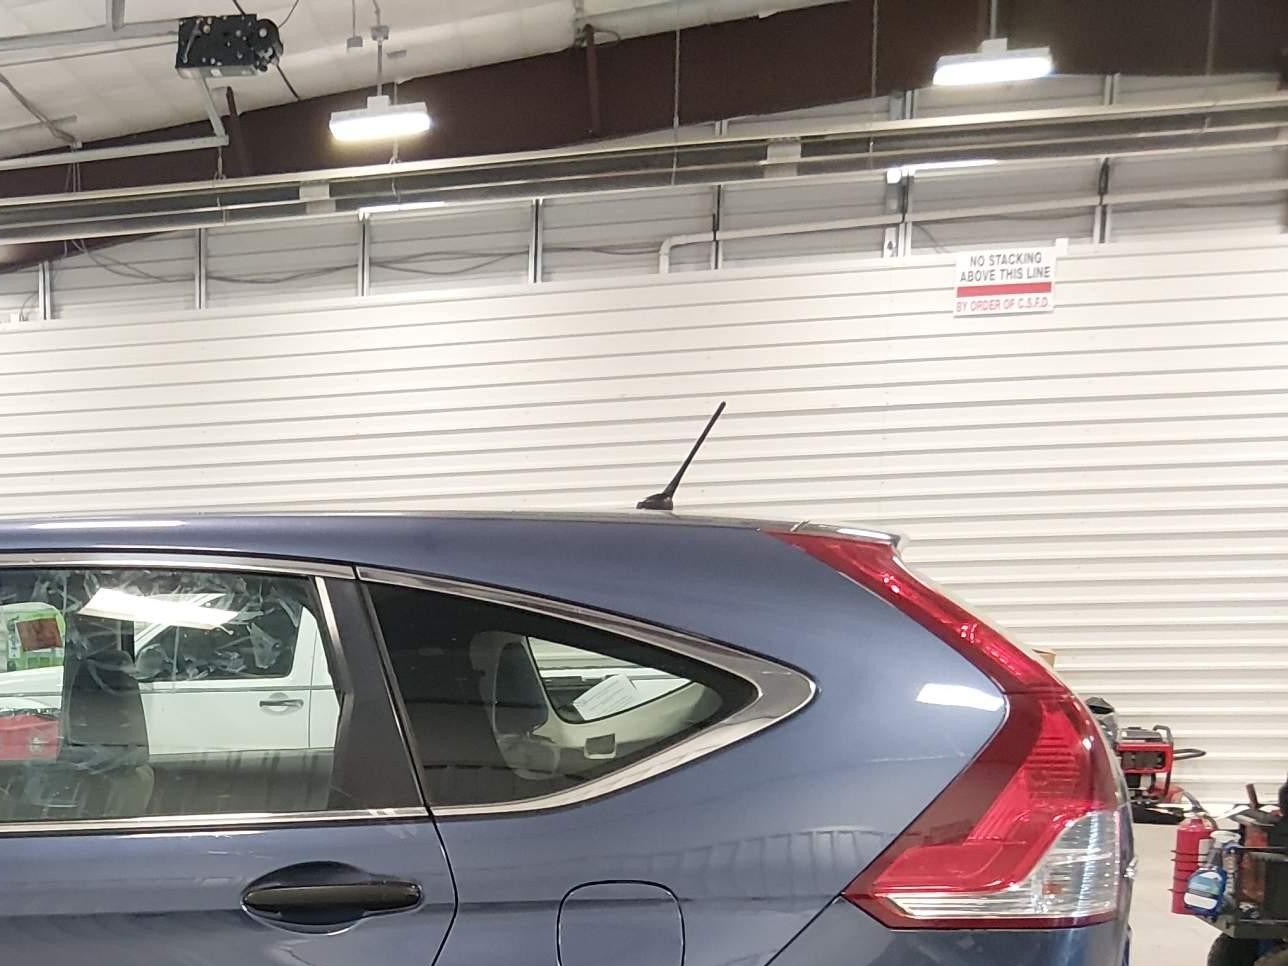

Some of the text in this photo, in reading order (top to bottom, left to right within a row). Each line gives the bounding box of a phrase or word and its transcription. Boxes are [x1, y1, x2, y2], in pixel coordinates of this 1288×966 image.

[970, 253, 1042, 267] NO STACKING
[960, 266, 1051, 282] ABOVE THIS LINE
[956, 301, 968, 312] BY
[970, 299, 1001, 312] ORDER
[1003, 298, 1015, 310] OF
